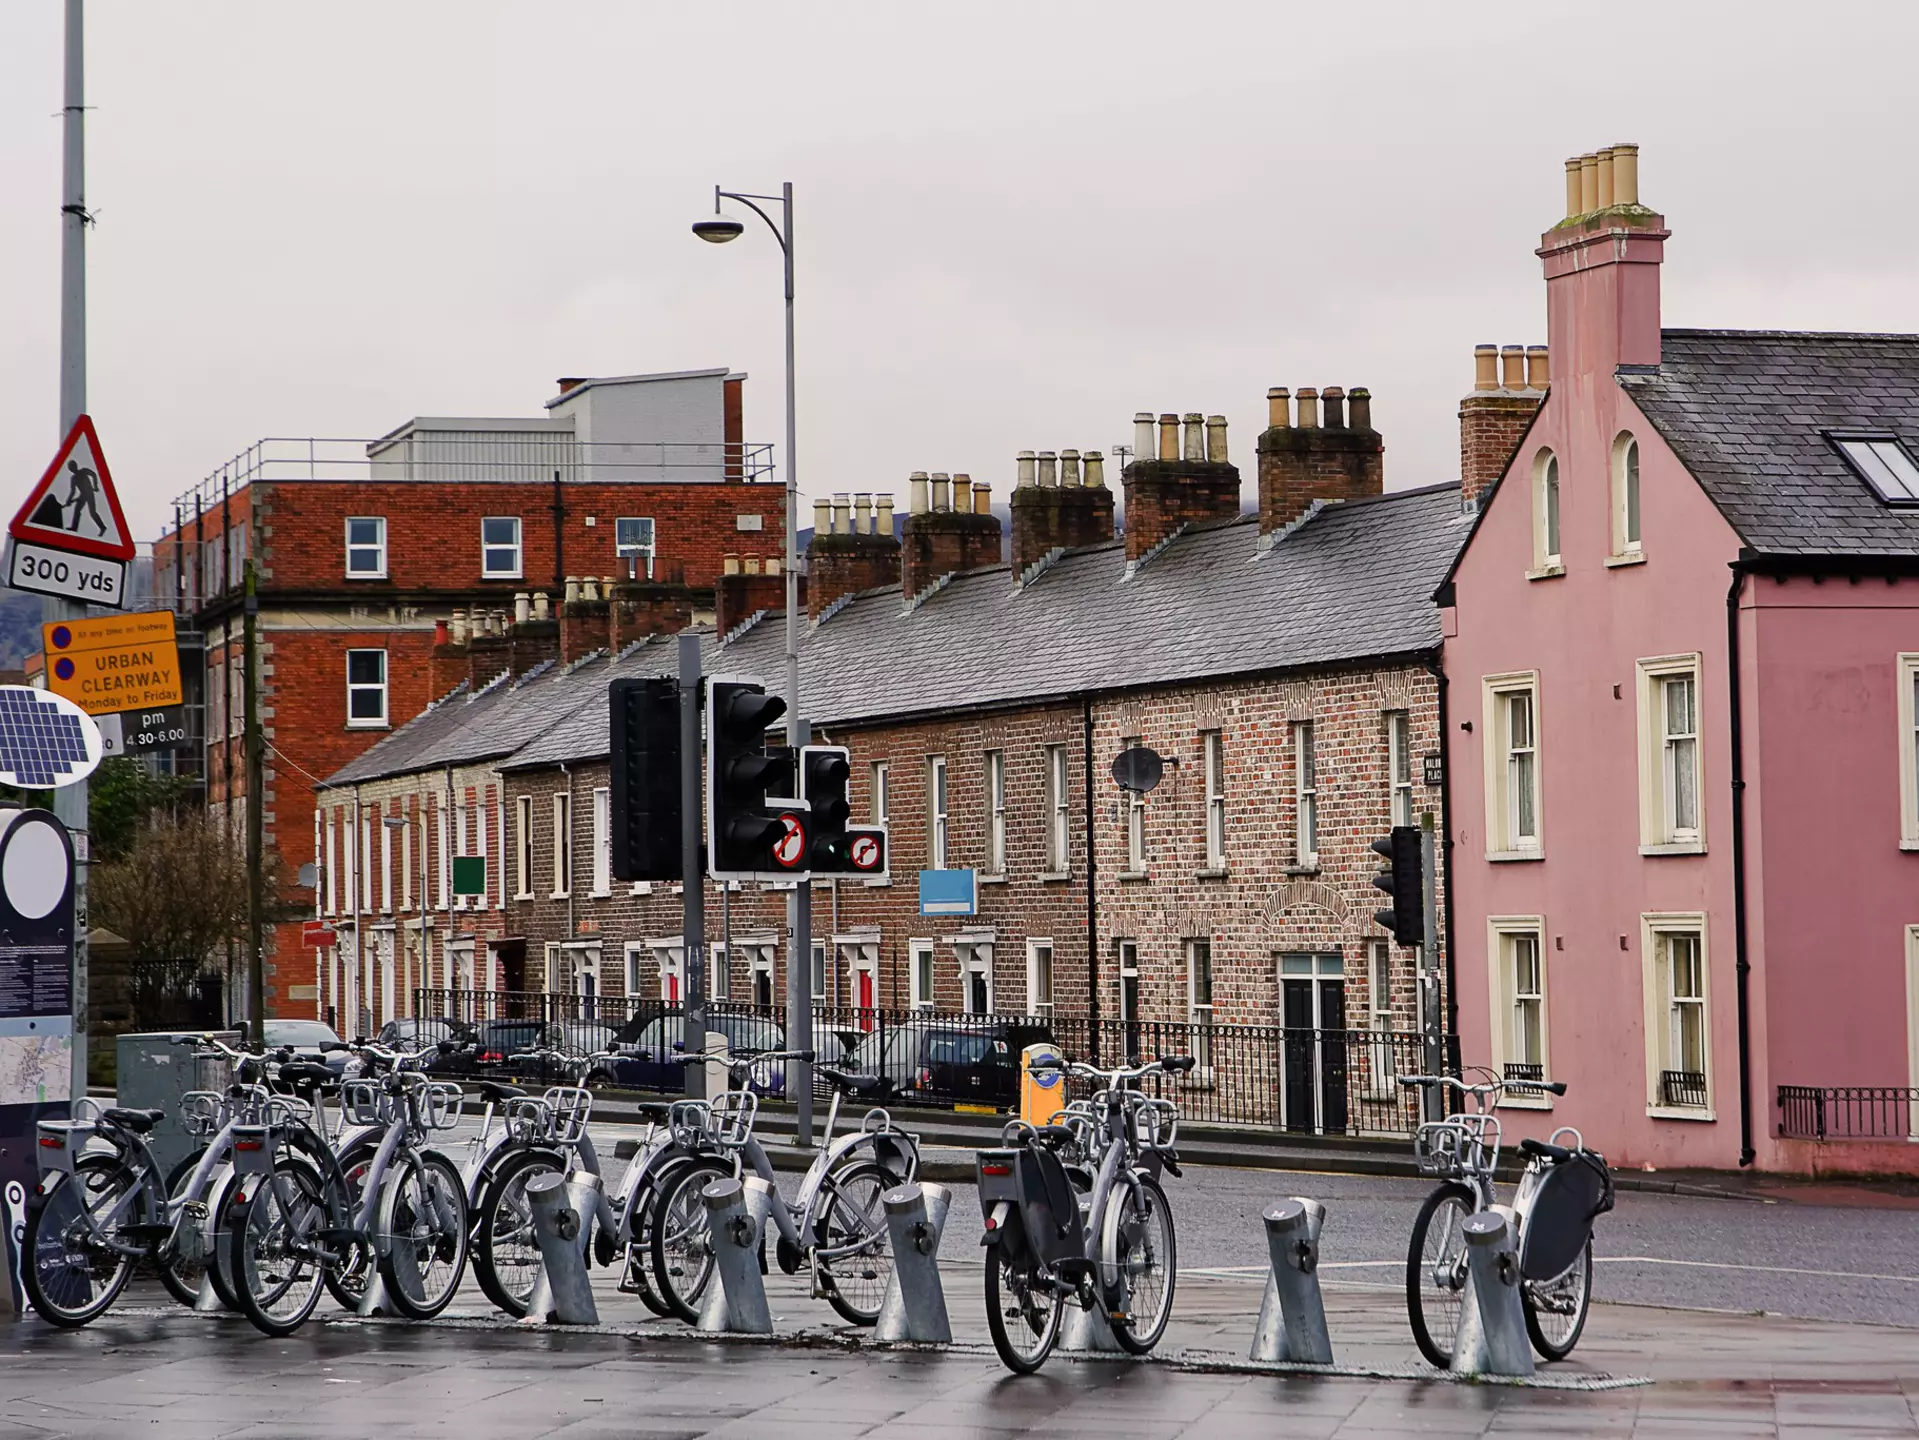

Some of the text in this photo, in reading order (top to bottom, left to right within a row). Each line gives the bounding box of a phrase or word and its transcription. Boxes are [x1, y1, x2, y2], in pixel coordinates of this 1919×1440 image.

[21, 555, 113, 593] 300 yds
[137, 623, 168, 632] footway
[95, 651, 154, 671] URBAN
[81, 669, 171, 693] CLEARWAY
[78, 689, 178, 709] Monday to Friday
[142, 712, 165, 729] pm
[126, 728, 185, 746] 4.30-6.00
[1425, 758, 1442, 769] MALON
